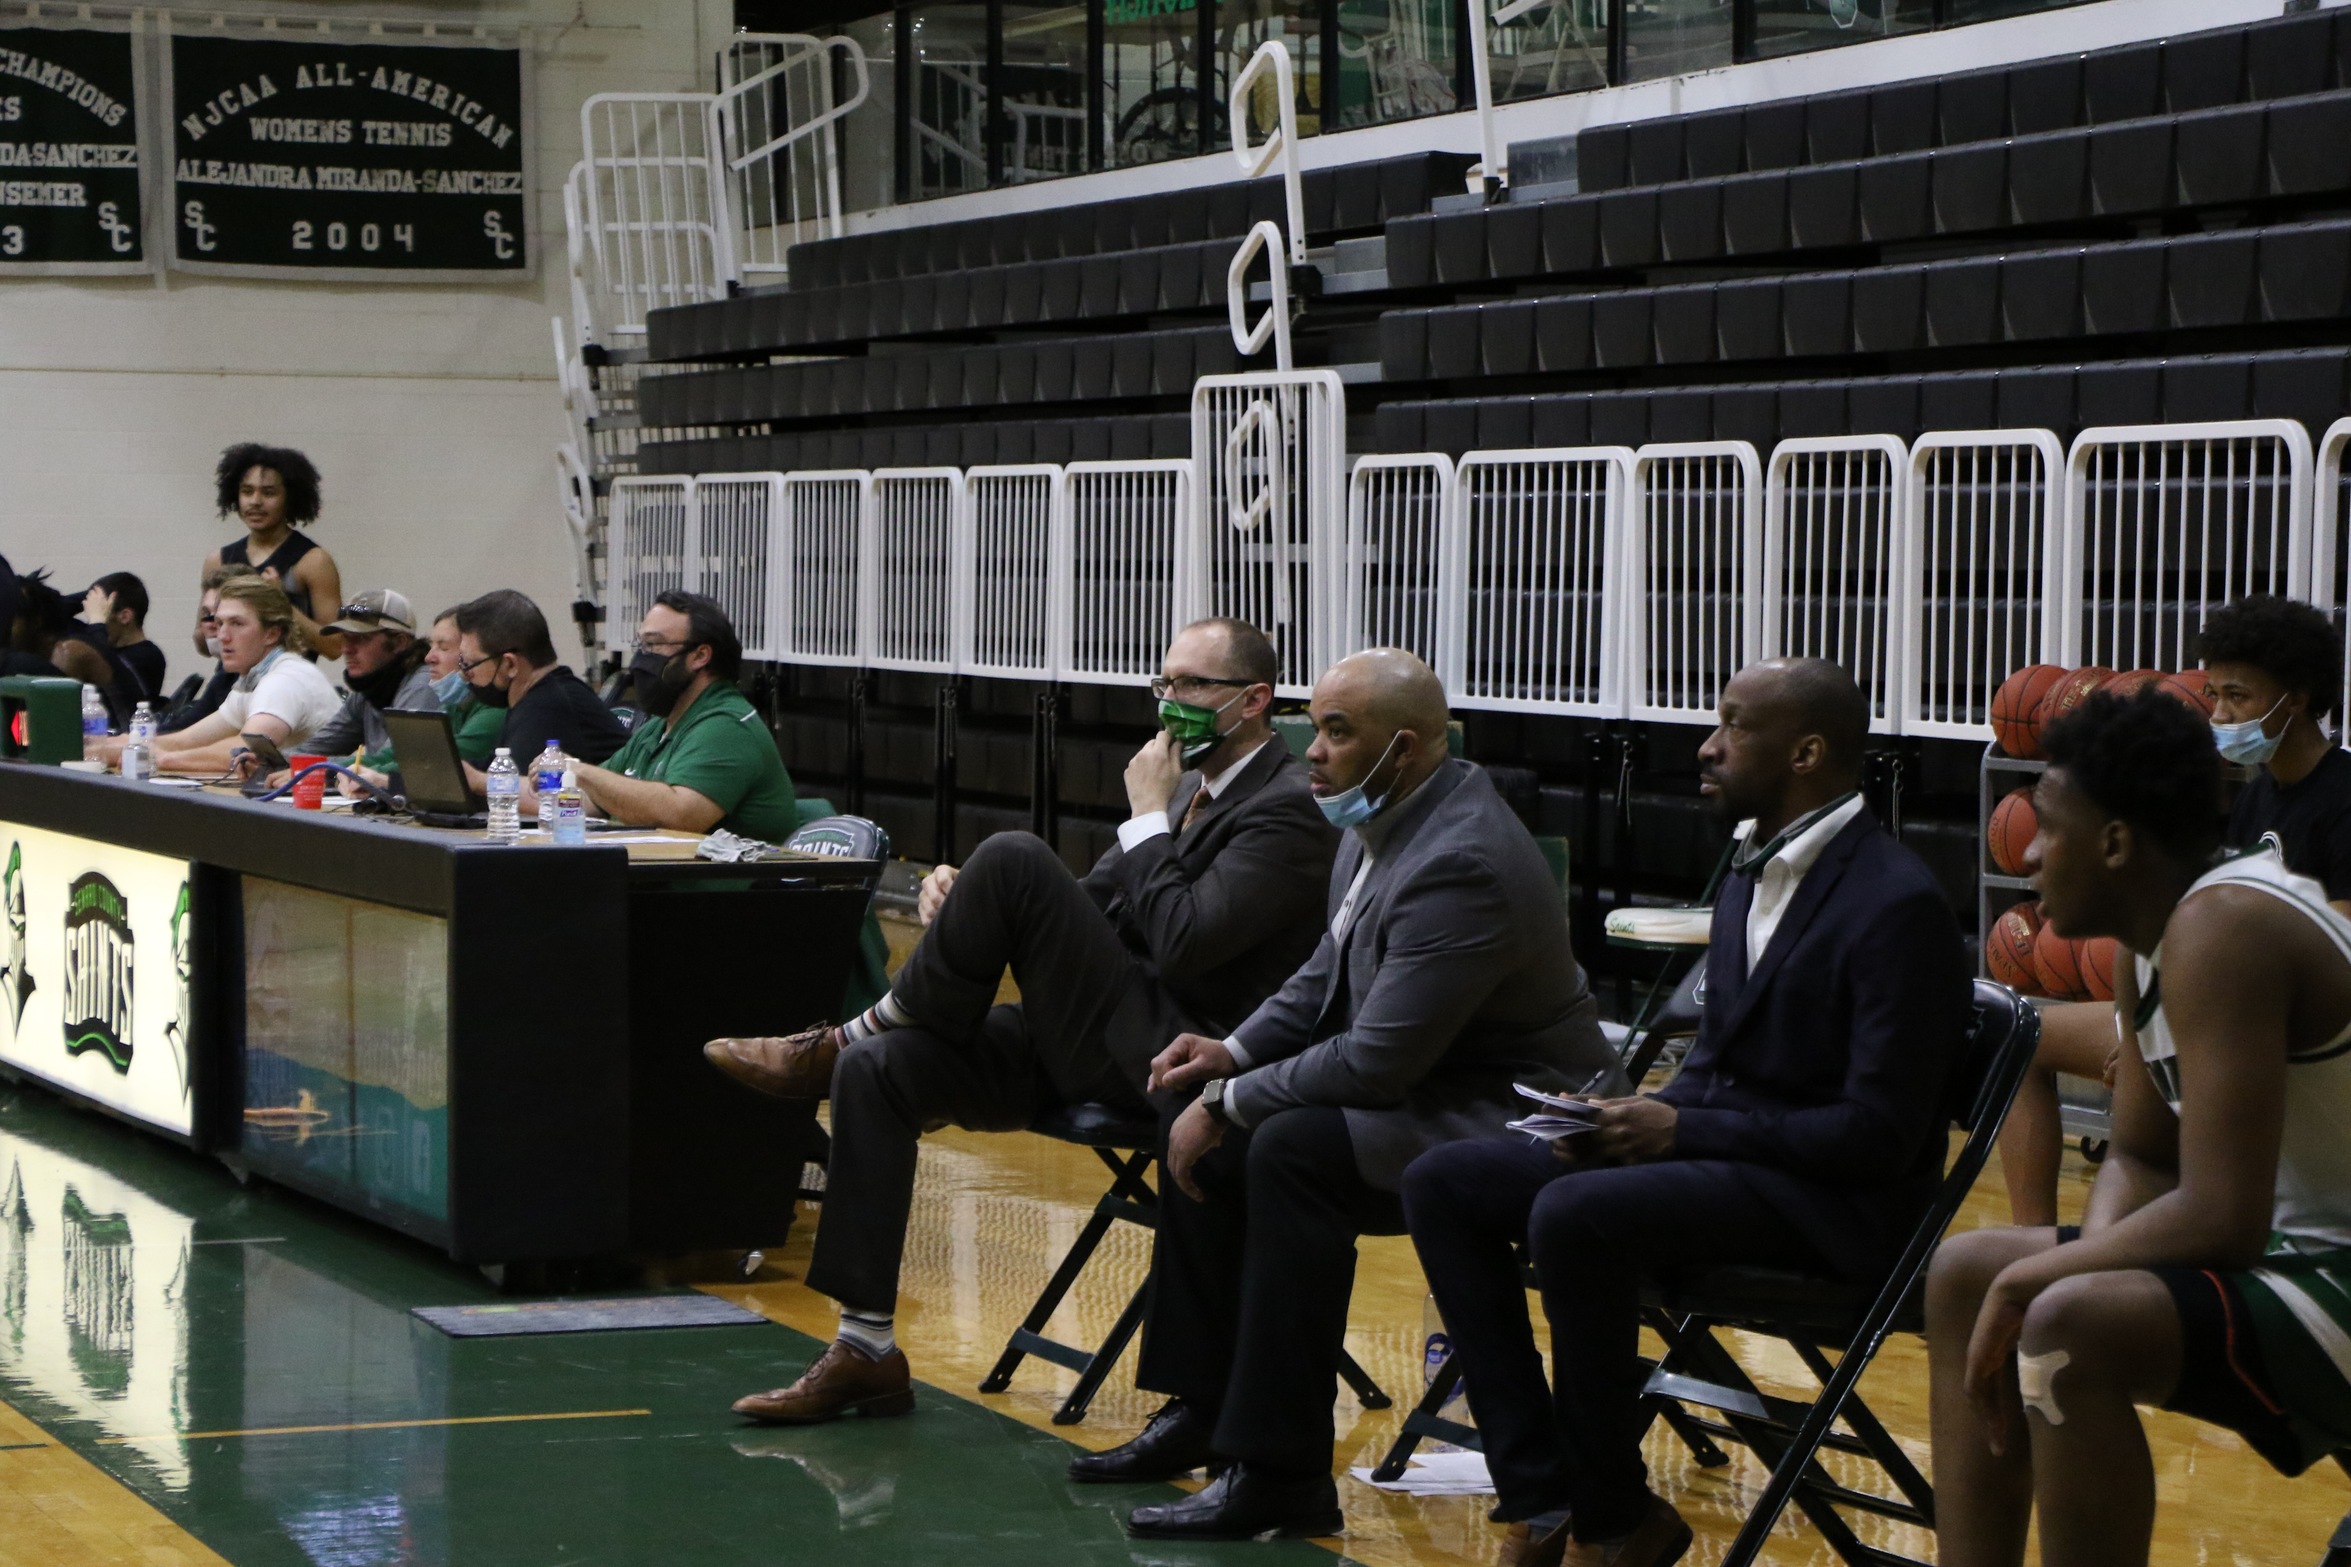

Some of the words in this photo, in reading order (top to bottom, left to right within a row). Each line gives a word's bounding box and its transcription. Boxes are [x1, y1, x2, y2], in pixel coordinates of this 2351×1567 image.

[182, 74, 278, 141] NJCAA
[296, 63, 514, 149] ALL-AMERICAN
[250, 117, 353, 143] WOMENS
[362, 120, 452, 147] TENNIS
[176, 158, 312, 190] ALEJANDRA
[316, 166, 522, 194] MIRANDA-SANCHEZ
[64, 919, 133, 1046] SAINTS
